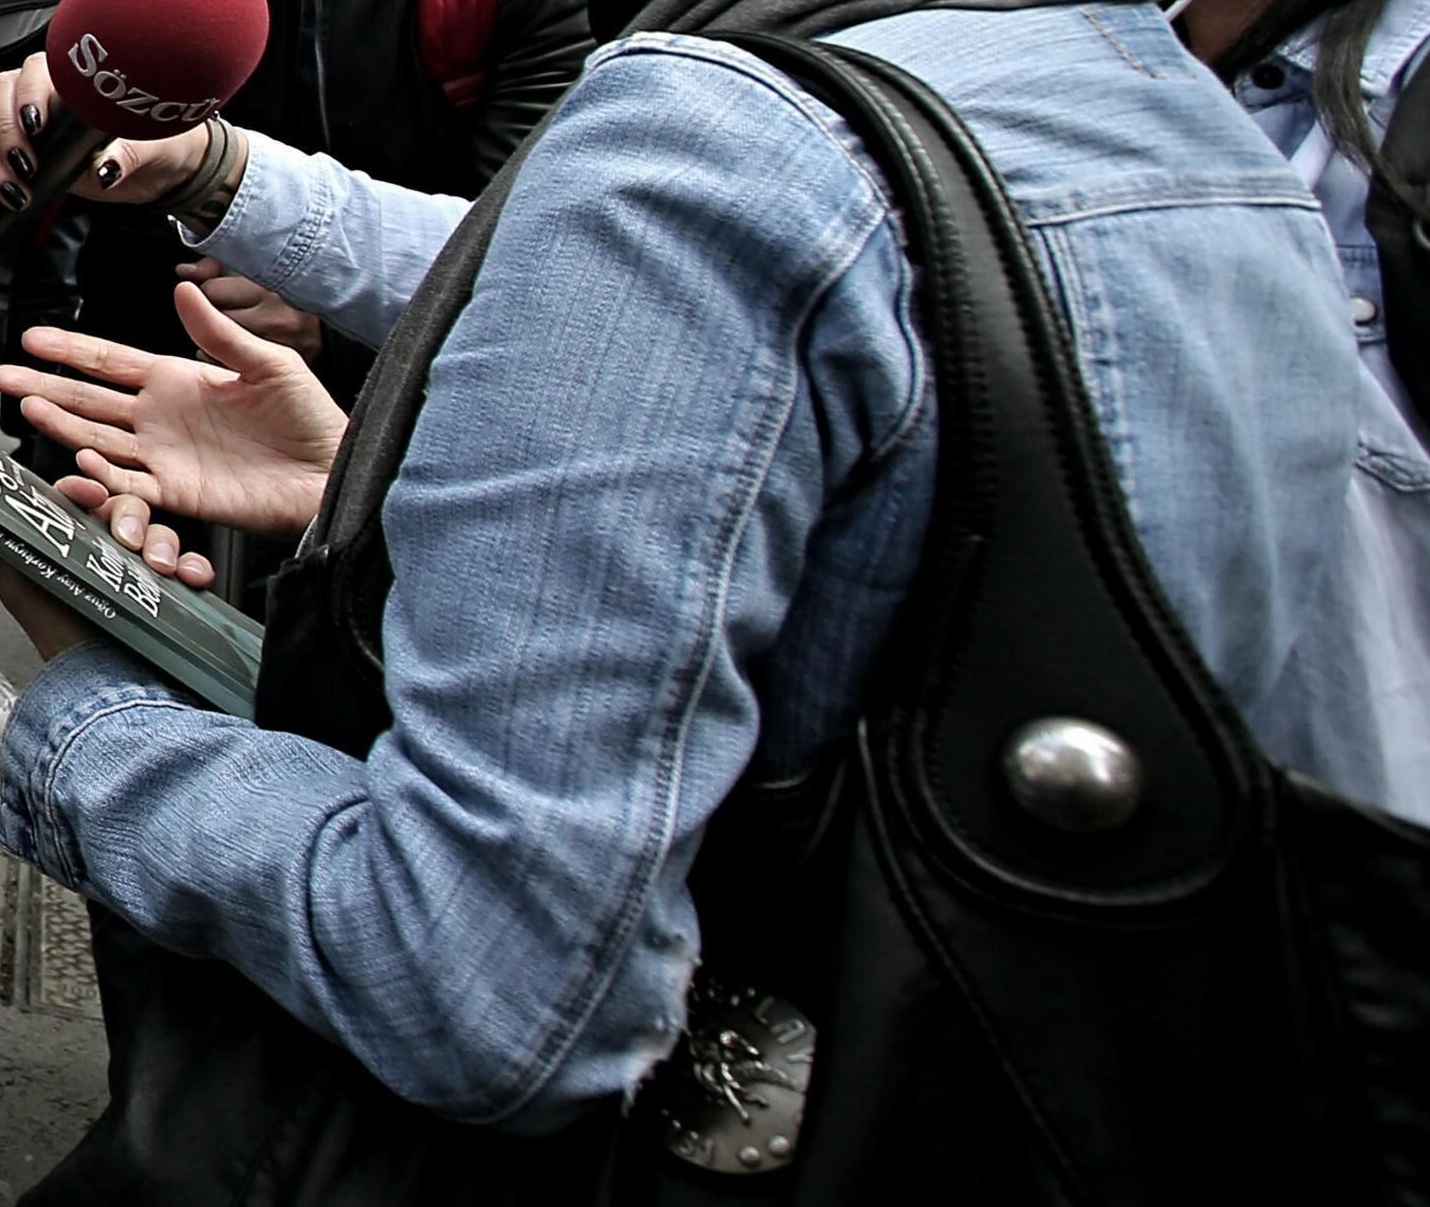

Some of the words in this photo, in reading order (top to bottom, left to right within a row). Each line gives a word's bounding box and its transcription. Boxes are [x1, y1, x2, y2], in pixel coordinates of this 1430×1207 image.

[4, 539, 57, 580] Korkuyu
[56, 574, 84, 597] Atay
[83, 593, 117, 620] Oğuz
